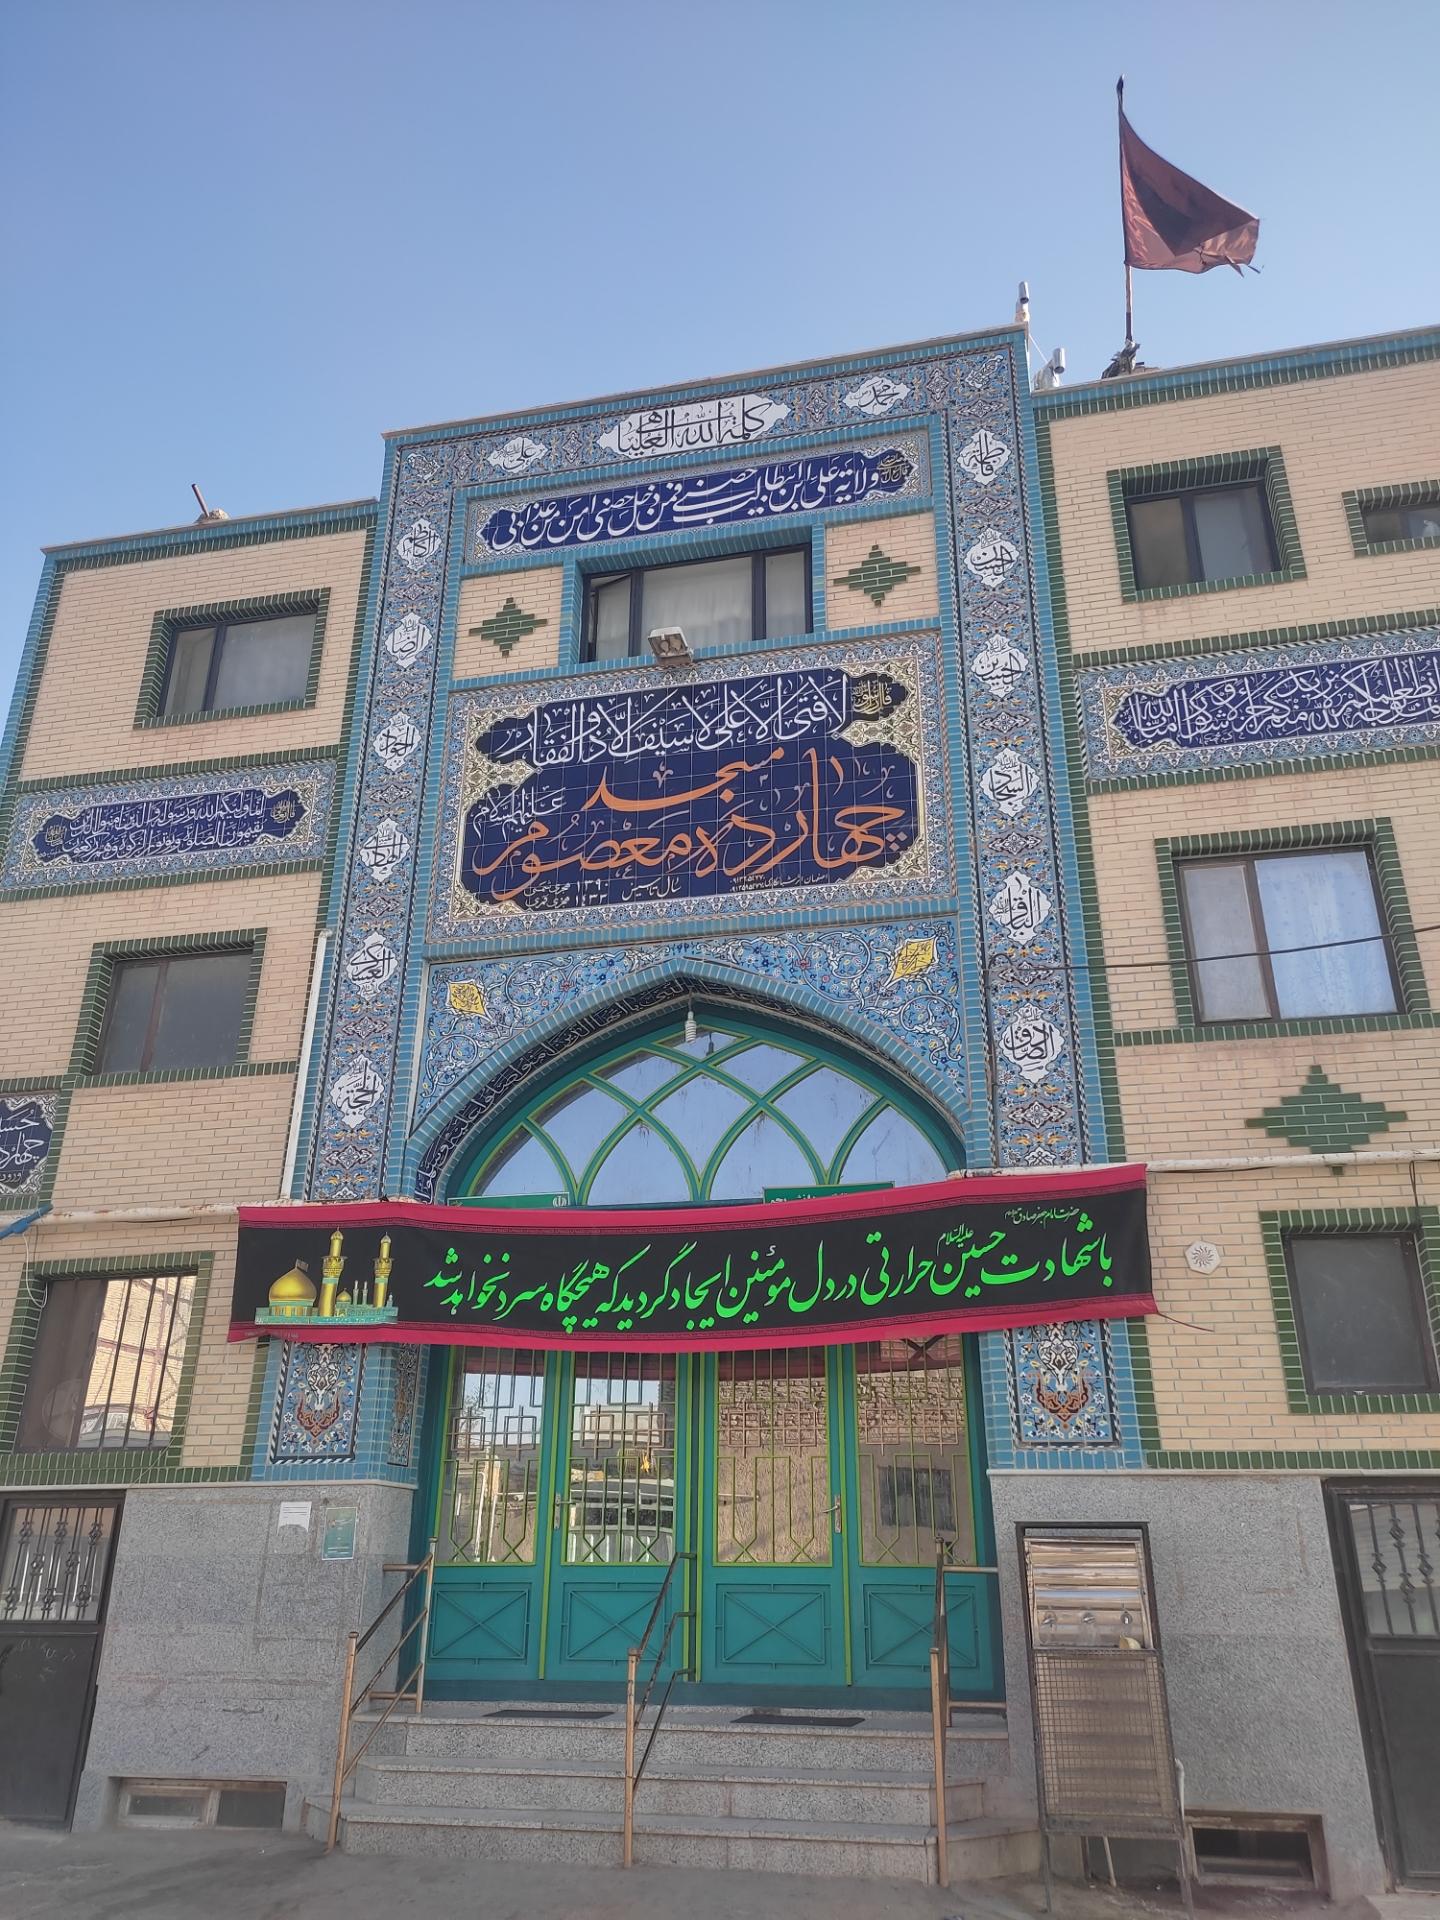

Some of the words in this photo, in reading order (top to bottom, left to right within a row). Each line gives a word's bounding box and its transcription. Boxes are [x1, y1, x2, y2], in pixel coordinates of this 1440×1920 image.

[858, 384, 900, 408] محمد
[503, 439, 536, 469] علی
[581, 747, 784, 812] مسجد
[695, 747, 907, 877] چهارده
[472, 821, 692, 900] معصوم
[422, 1247, 464, 1288] شد
[594, 1243, 651, 1315] که
[788, 1239, 836, 1313] دل
[860, 1231, 934, 1306] حرارتی
[929, 1230, 1006, 1298] حسین
[981, 1212, 1101, 1285] شهادت
[1099, 1232, 1113, 1288] با
[439, 1252, 511, 1316] نخواهد
[491, 1281, 548, 1321] سرد
[612, 1241, 697, 1331] گردید
[667, 1254, 732, 1331] ایجاد
[833, 1274, 857, 1301] در
